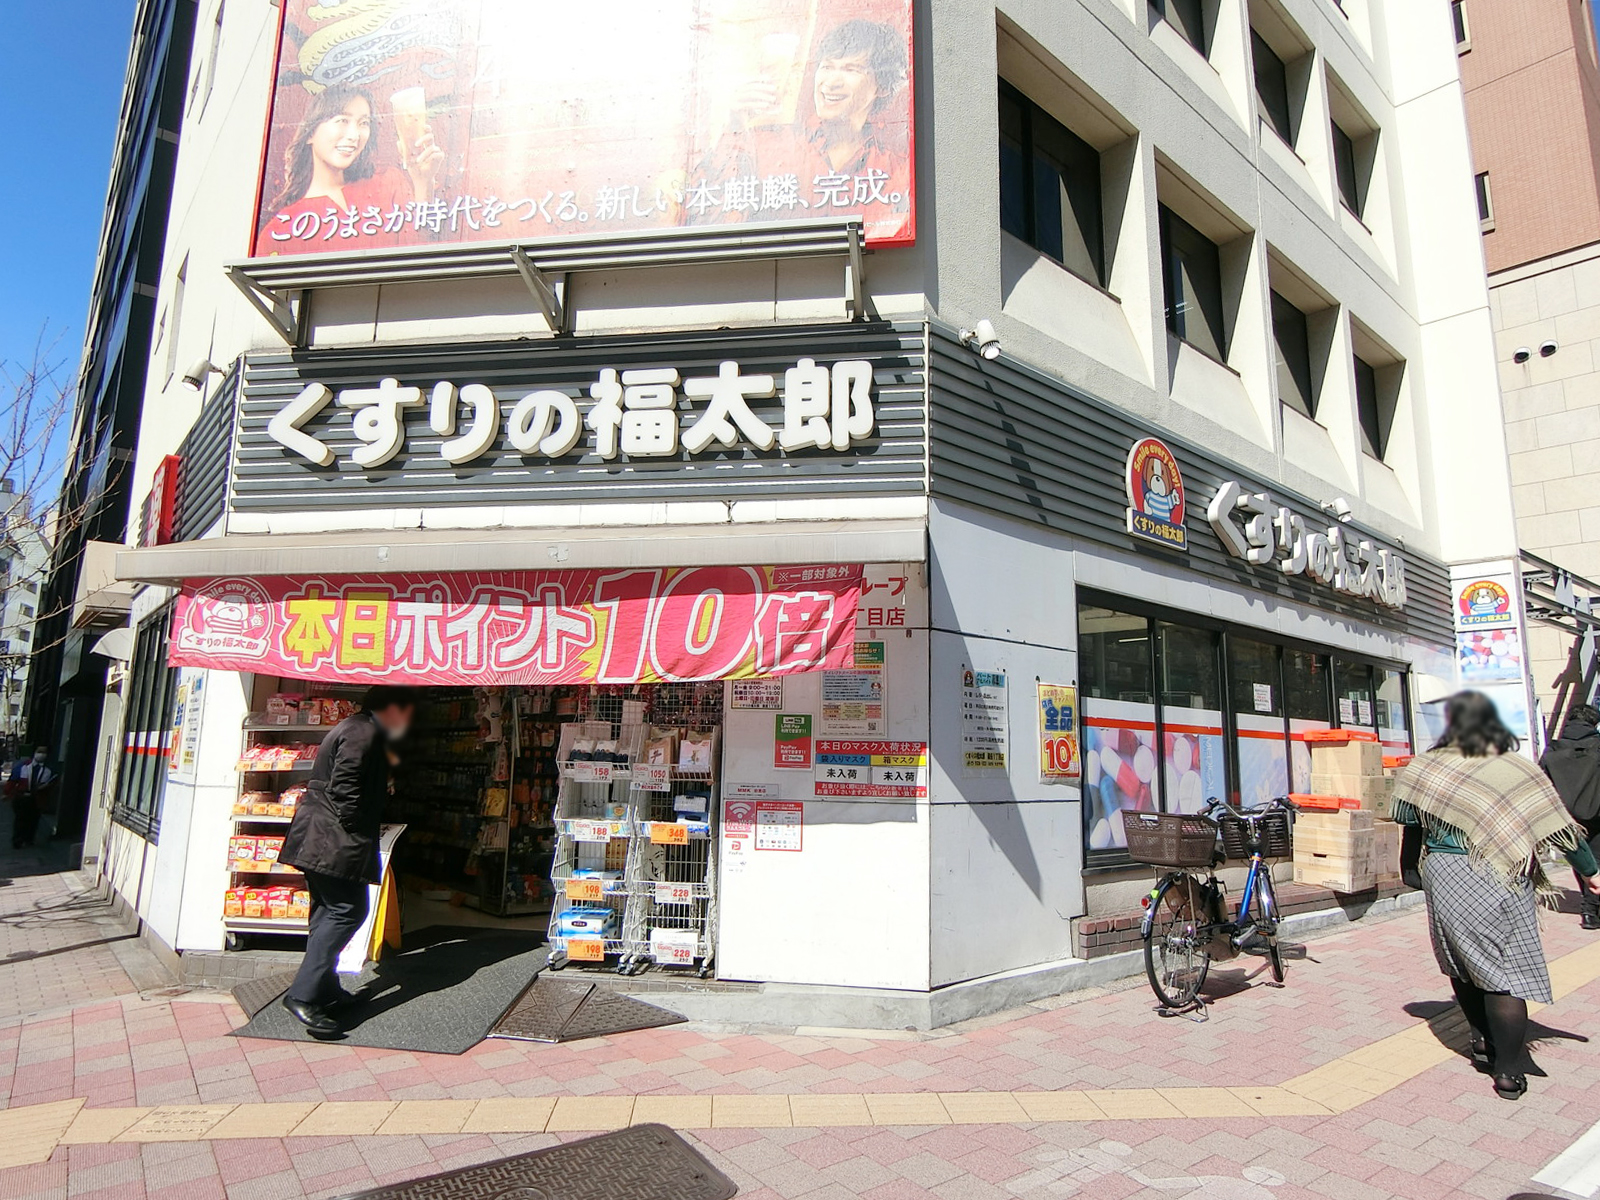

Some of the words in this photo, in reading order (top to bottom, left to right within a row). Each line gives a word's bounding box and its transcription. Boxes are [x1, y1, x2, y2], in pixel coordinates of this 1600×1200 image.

[267, 357, 874, 468] くすりの福太郎
[1133, 445, 1150, 472] Smile
[1150, 444, 1169, 463] every
[1133, 515, 1184, 543] くすりの福太郎
[225, 583, 251, 596] every
[184, 633, 260, 651] くすりの福太郎
[1045, 705, 1073, 732] 全品
[820, 741, 922, 752] 本日のマスク入荷状況
[883, 756, 915, 764] 箱マスク
[1044, 737, 1072, 772] 10
[594, 767, 610, 776] 158
[650, 769, 666, 778] 1050
[826, 768, 858, 779] 未入荷
[883, 771, 915, 782] 未入荷
[592, 827, 607, 836] 188
[668, 828, 684, 838] 348
[585, 885, 600, 894] 198
[672, 889, 689, 897] 228
[585, 944, 601, 953] 198
[673, 949, 690, 957] 228
